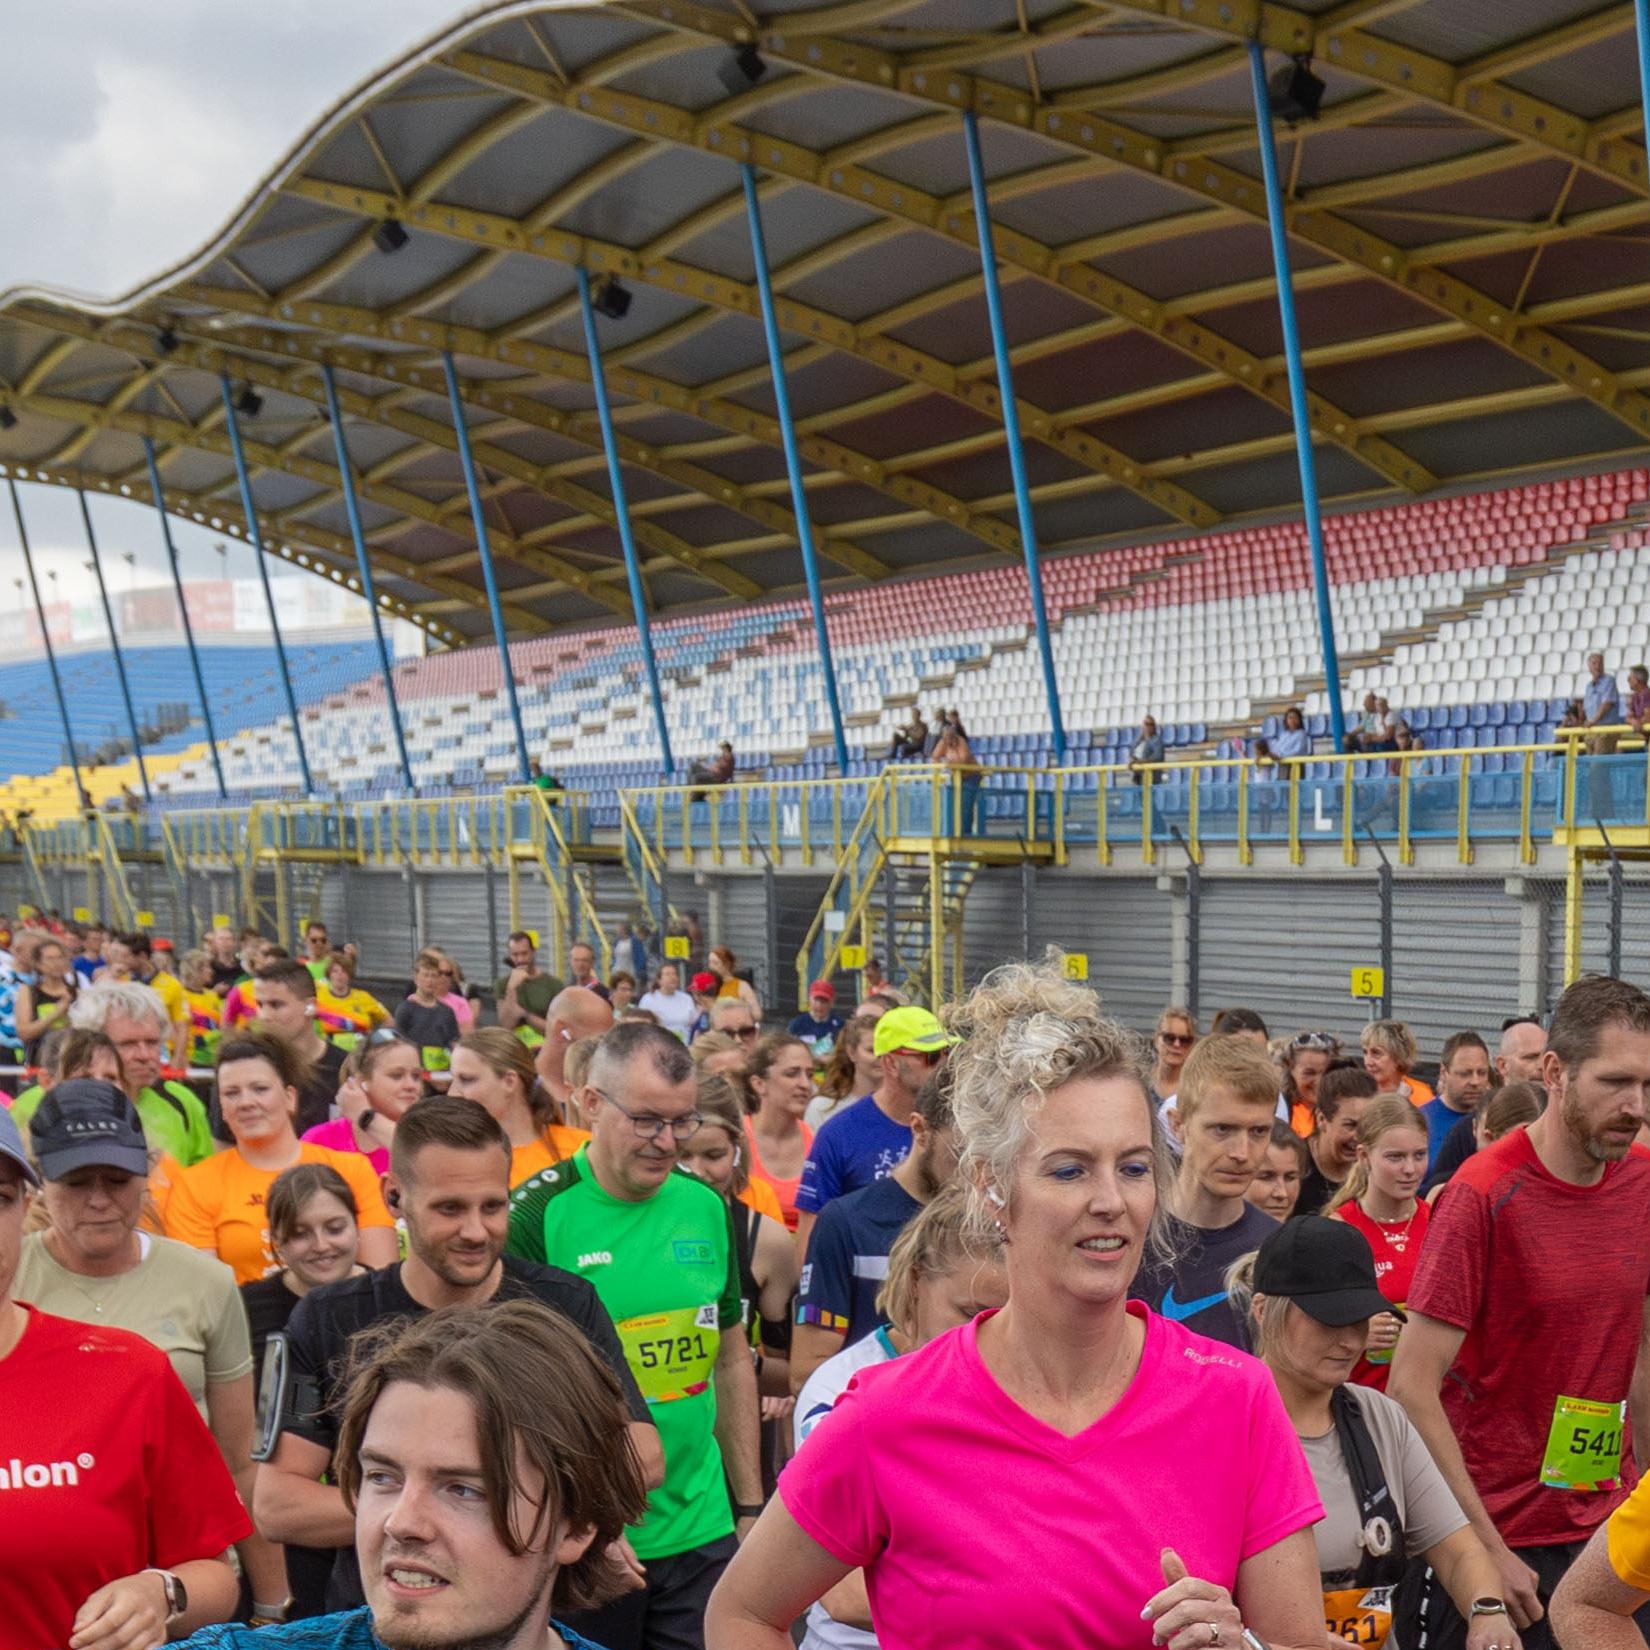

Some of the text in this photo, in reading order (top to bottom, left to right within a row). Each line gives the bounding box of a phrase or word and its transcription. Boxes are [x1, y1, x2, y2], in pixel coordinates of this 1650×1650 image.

[783, 803, 801, 838] M
[1314, 788, 1332, 831] L
[1066, 957, 1080, 978] 6
[1360, 972, 1374, 995] 5
[577, 1251, 613, 1268] JAKO
[638, 1333, 709, 1369] 5721
